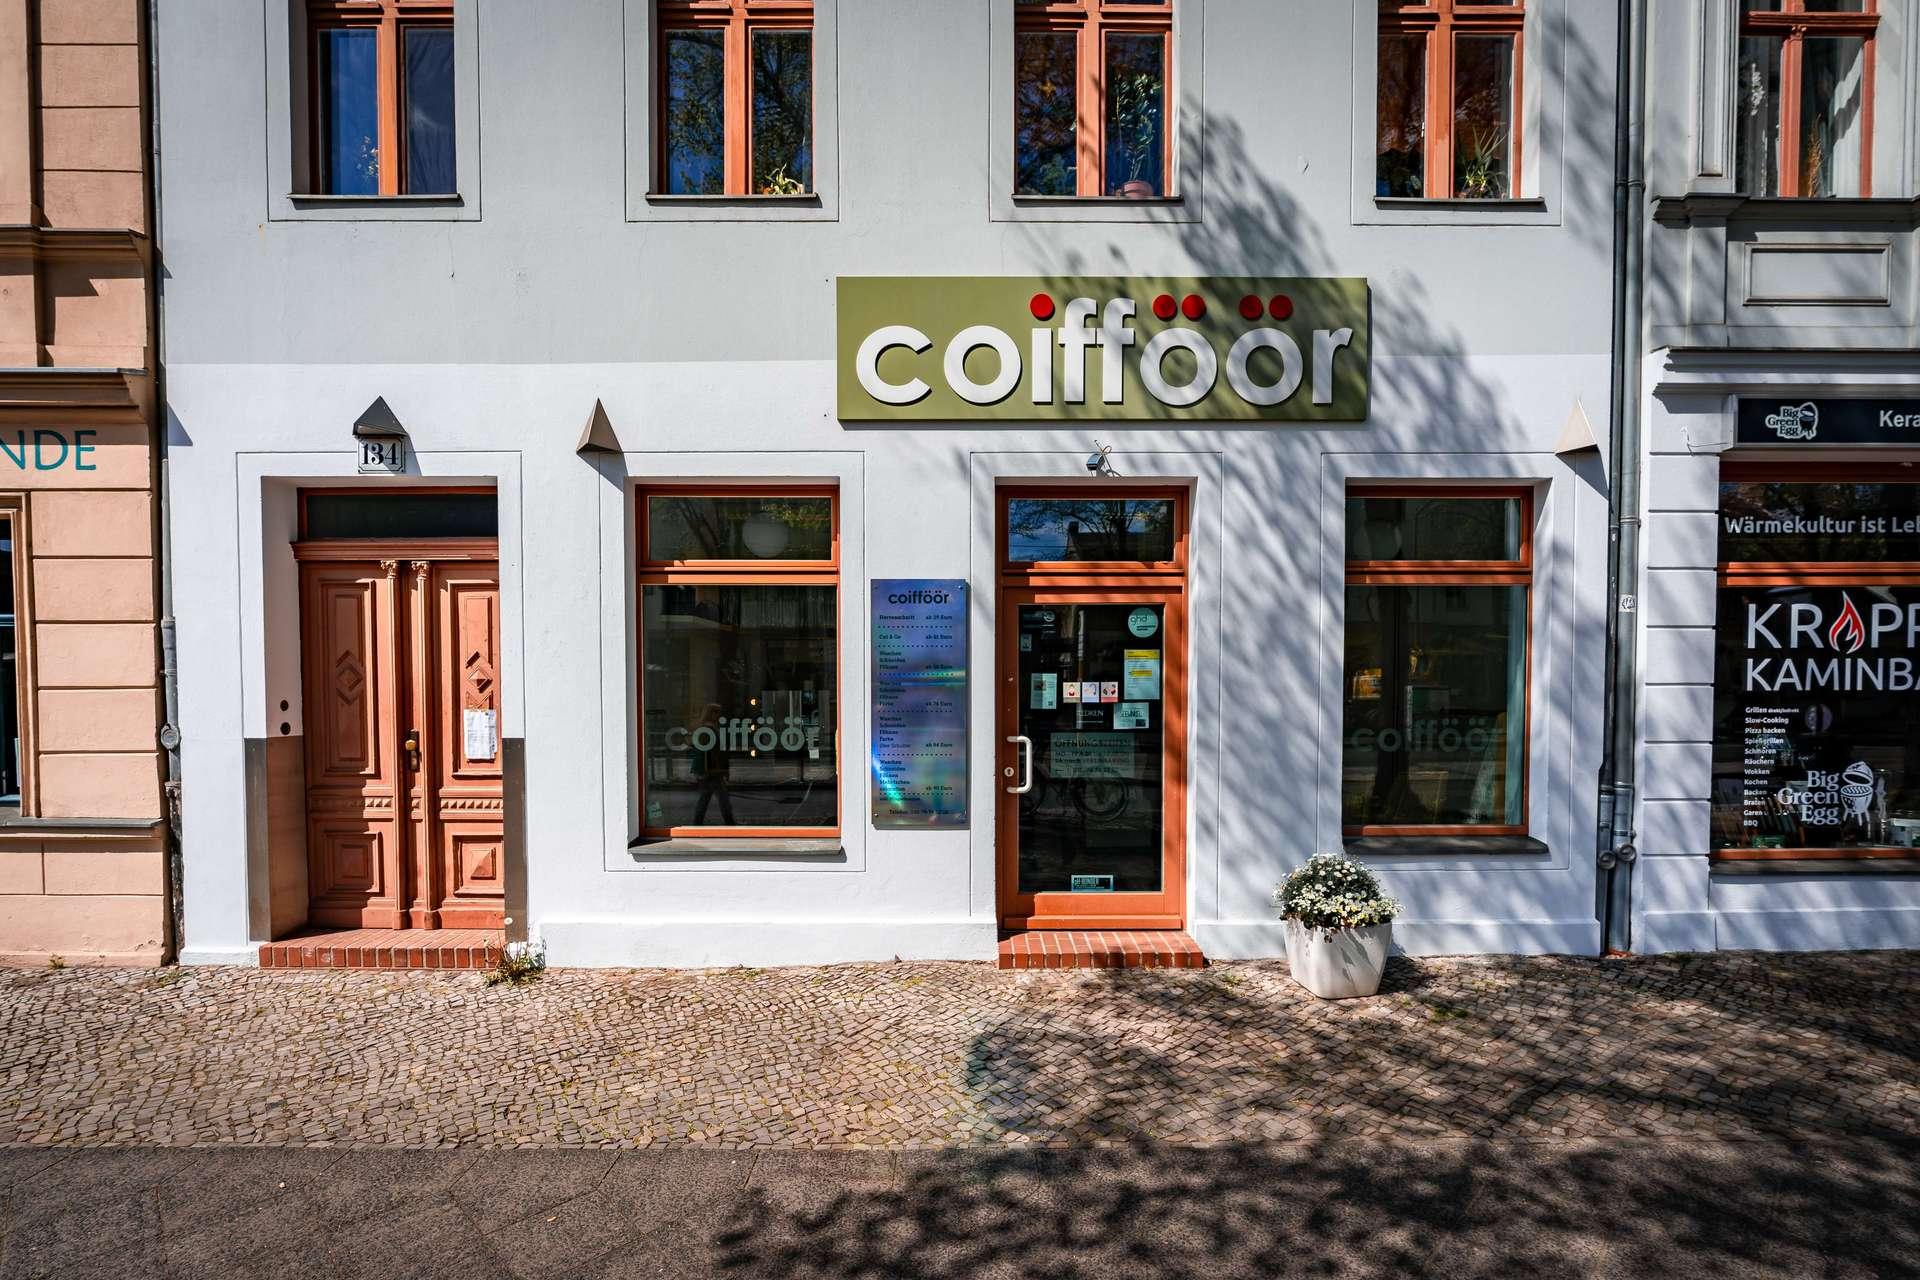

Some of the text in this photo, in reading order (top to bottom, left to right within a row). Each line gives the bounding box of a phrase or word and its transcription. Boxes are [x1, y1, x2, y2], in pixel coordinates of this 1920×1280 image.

[856, 293, 1352, 406] coifföör
[1768, 416, 1798, 426] Green
[1782, 408, 1799, 419] Big
[1780, 426, 1799, 436] Egg
[361, 442, 400, 465] 134
[1724, 516, 1856, 533] Wärmekultur
[1861, 515, 1886, 533] ist
[888, 590, 949, 604] coifföör
[1747, 658, 1920, 691] KAMINB
[1807, 770, 1839, 791] Big
[1777, 787, 1840, 805] Green
[1801, 804, 1840, 825] Egg
